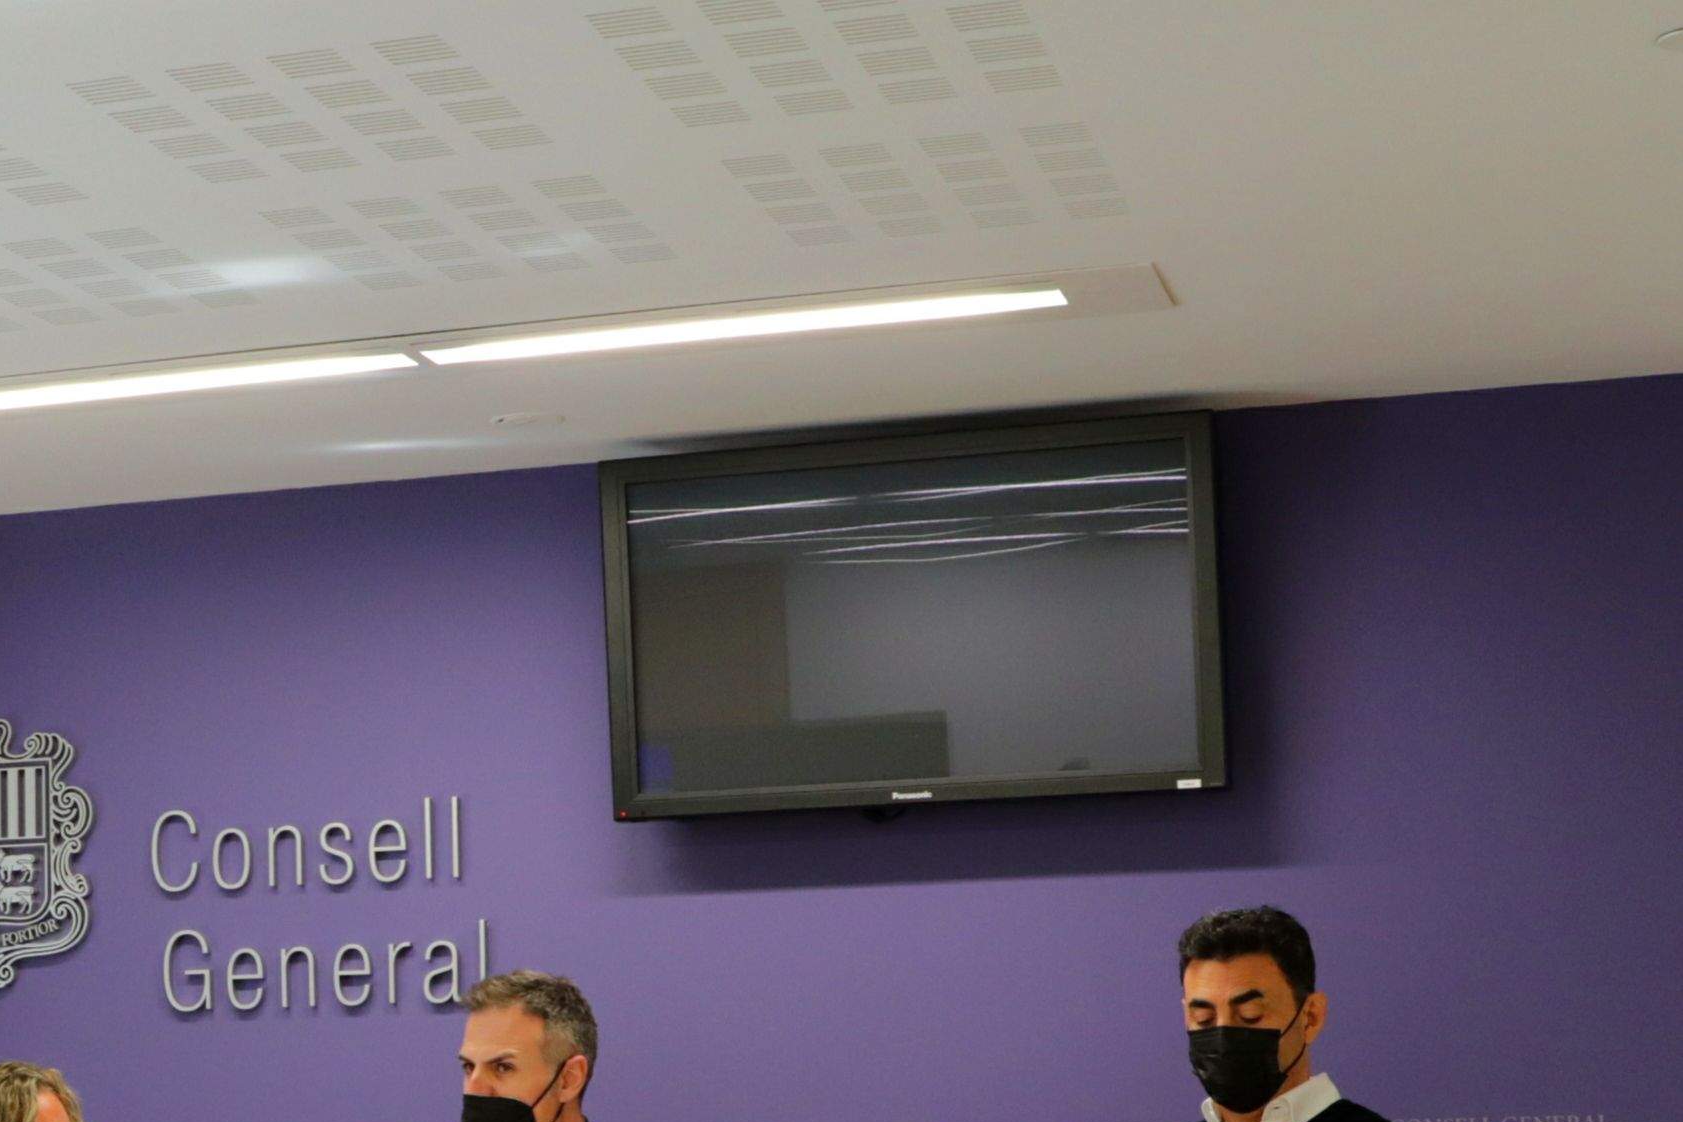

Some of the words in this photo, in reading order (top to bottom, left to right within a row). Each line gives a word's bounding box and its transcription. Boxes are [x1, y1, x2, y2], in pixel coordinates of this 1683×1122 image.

[891, 790, 934, 801] Panasonic
[151, 796, 461, 892] Consell
[1, 919, 59, 947] FORTIOR
[163, 919, 487, 1012] General
